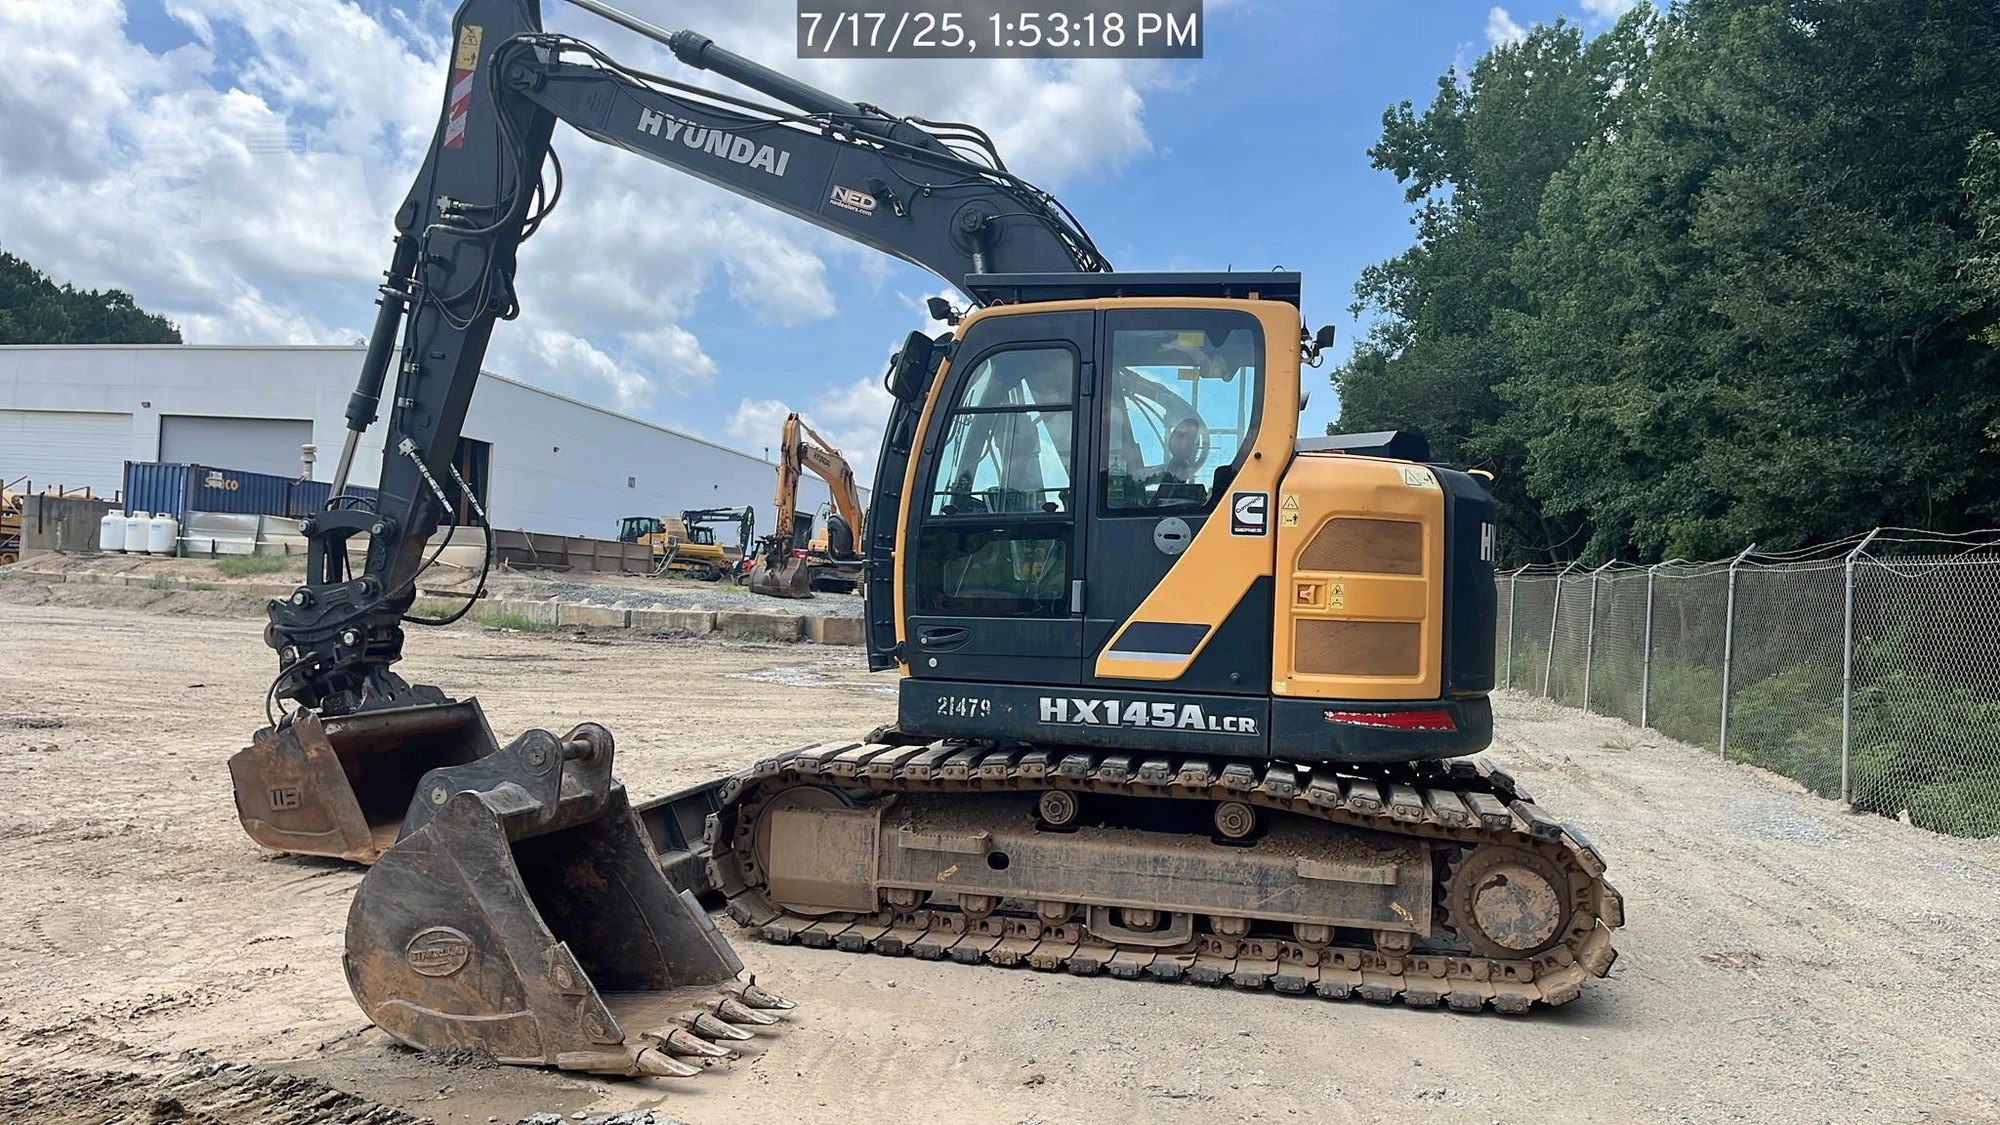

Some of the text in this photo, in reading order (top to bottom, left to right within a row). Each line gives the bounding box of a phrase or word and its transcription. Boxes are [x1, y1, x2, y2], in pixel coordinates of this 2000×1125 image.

[637, 107, 790, 177] HYUNDAI
[830, 184, 878, 211] NED
[936, 696, 991, 718] 21479
